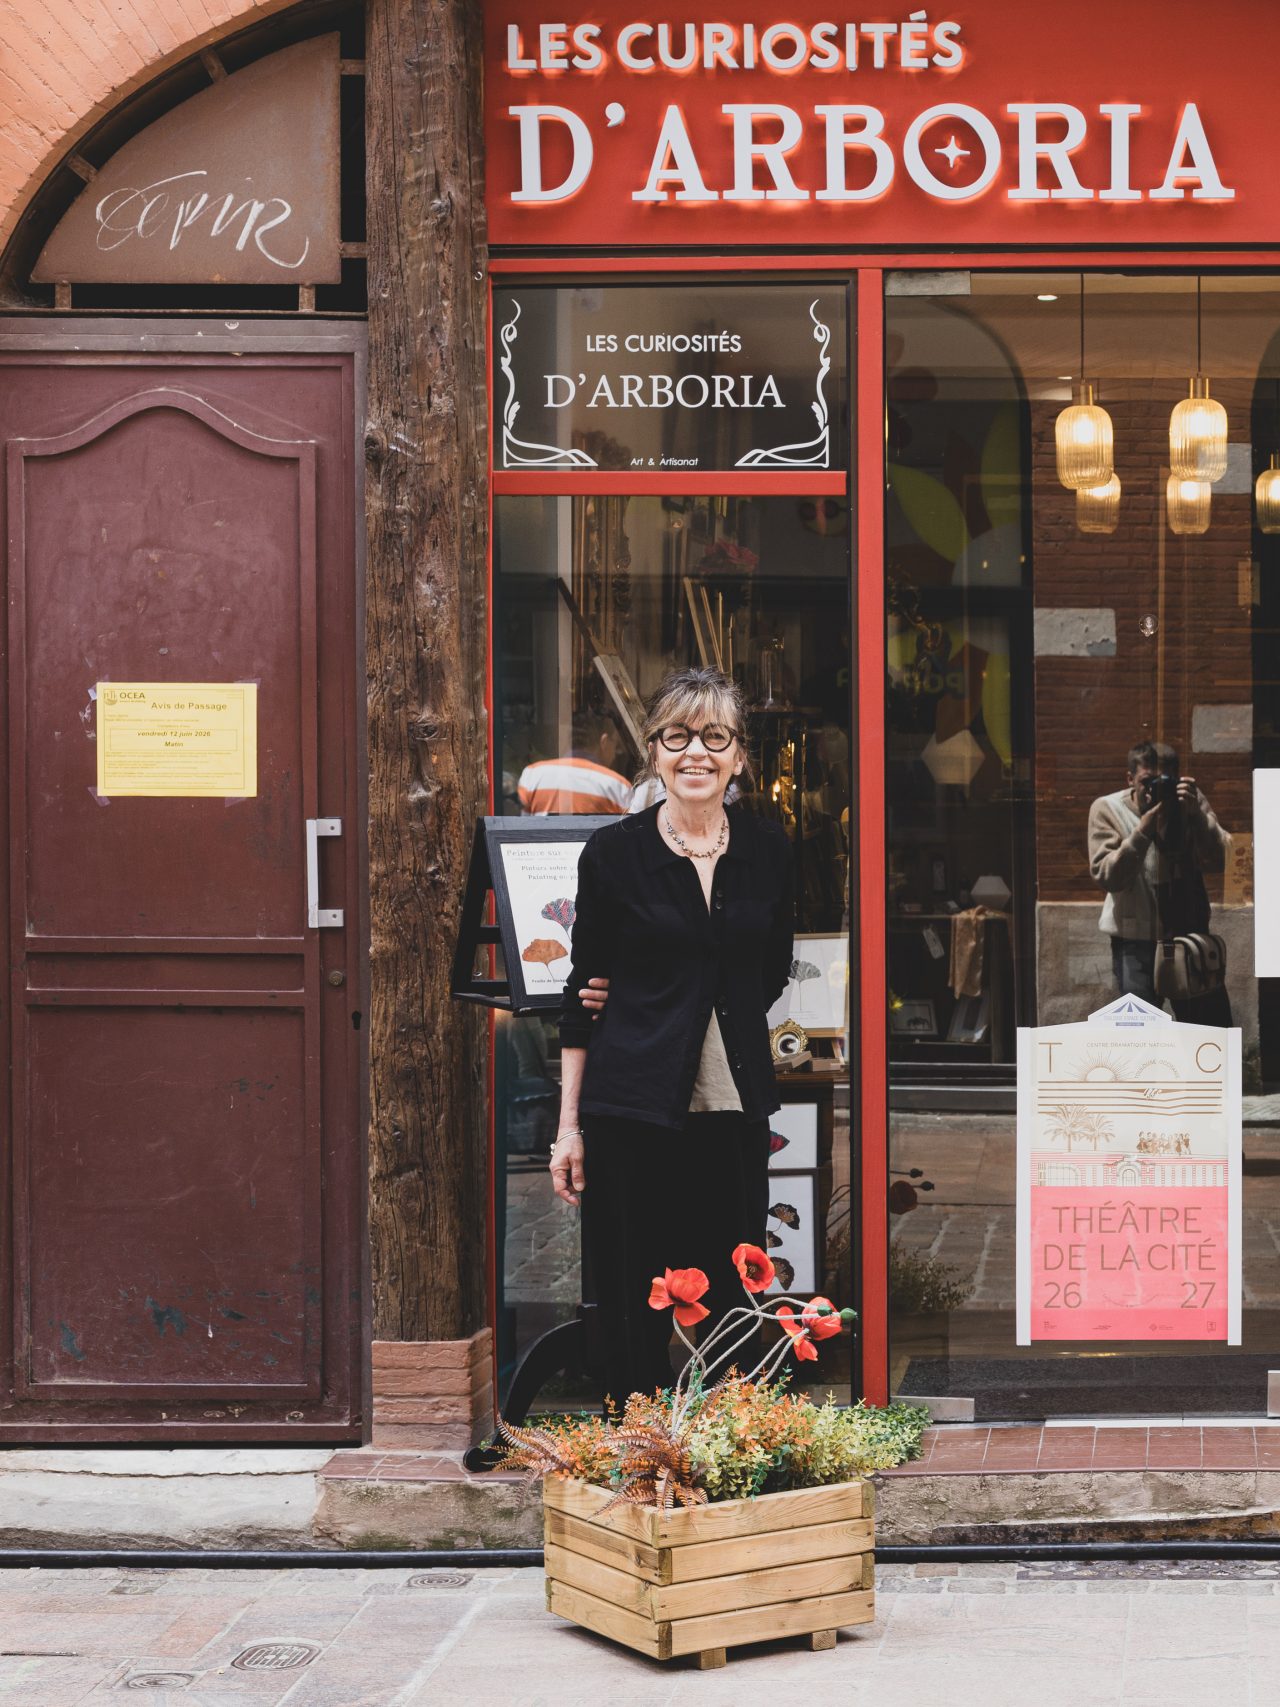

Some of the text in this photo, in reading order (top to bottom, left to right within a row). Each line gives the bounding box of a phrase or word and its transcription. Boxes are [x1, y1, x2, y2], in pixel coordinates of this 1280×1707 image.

[507, 10, 964, 70] LES CURIOSITÉS
[507, 102, 1236, 202] D'ARBORIA
[586, 330, 742, 353] LES CURIOSITÉS
[543, 372, 787, 409] D'ARBORIA
[630, 457, 699, 466] Art & Artisanat
[119, 691, 146, 700] OCEA
[151, 702, 228, 711] Avis de Passage
[1038, 1042, 1063, 1073] T
[1195, 1042, 1222, 1074] C
[1051, 1200, 1202, 1234] THÉÂTRE
[1043, 1237, 1217, 1271] DE LA CITÉ
[1043, 1281, 1217, 1309] 26 27
